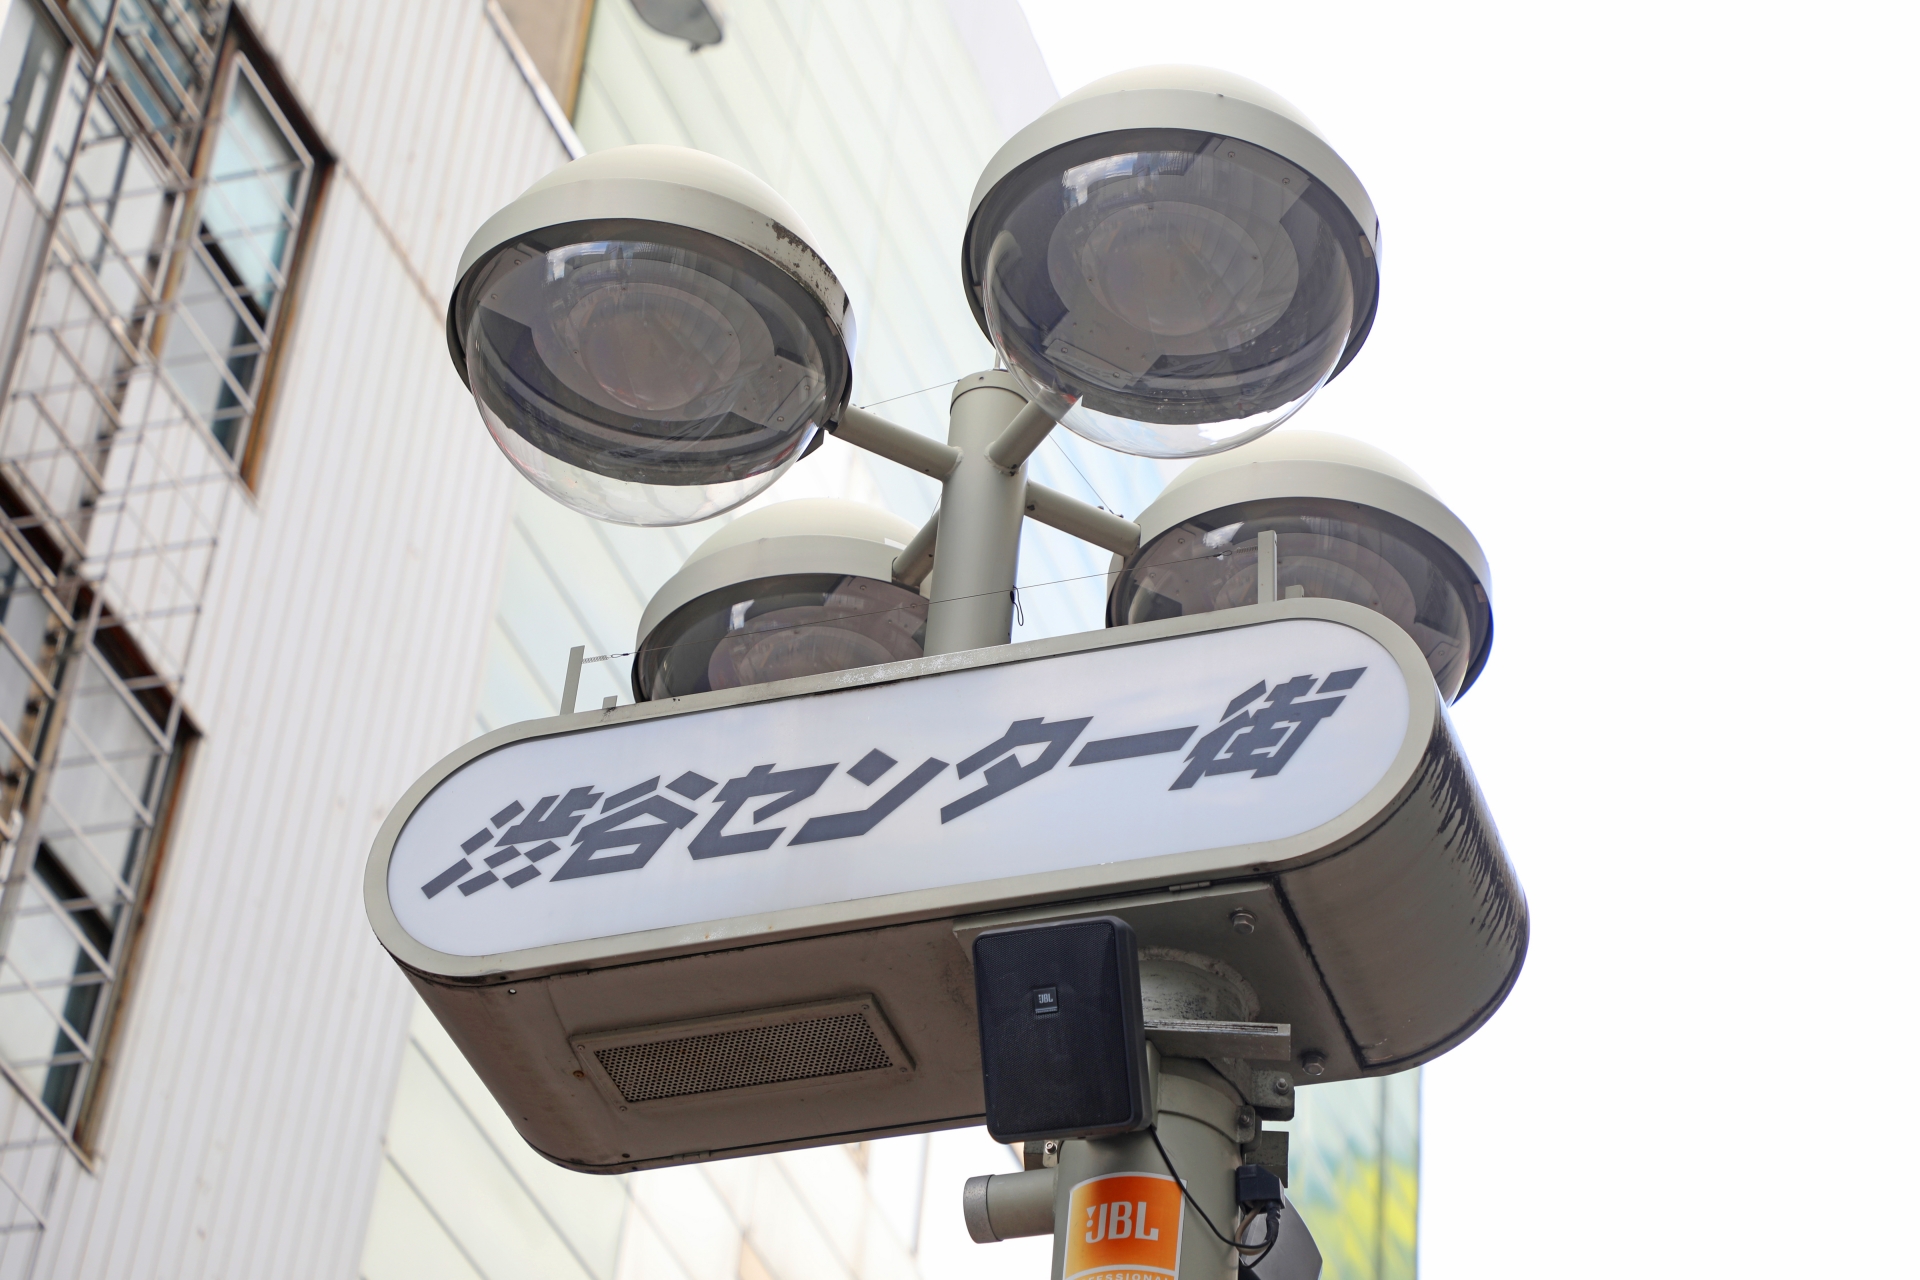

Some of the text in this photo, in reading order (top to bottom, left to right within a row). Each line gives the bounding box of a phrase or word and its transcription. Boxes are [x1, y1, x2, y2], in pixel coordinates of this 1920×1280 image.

[421, 667, 1368, 900] 渋谷センター街
[1038, 993, 1054, 1004] JBL
[1085, 1201, 1159, 1244] JBL
